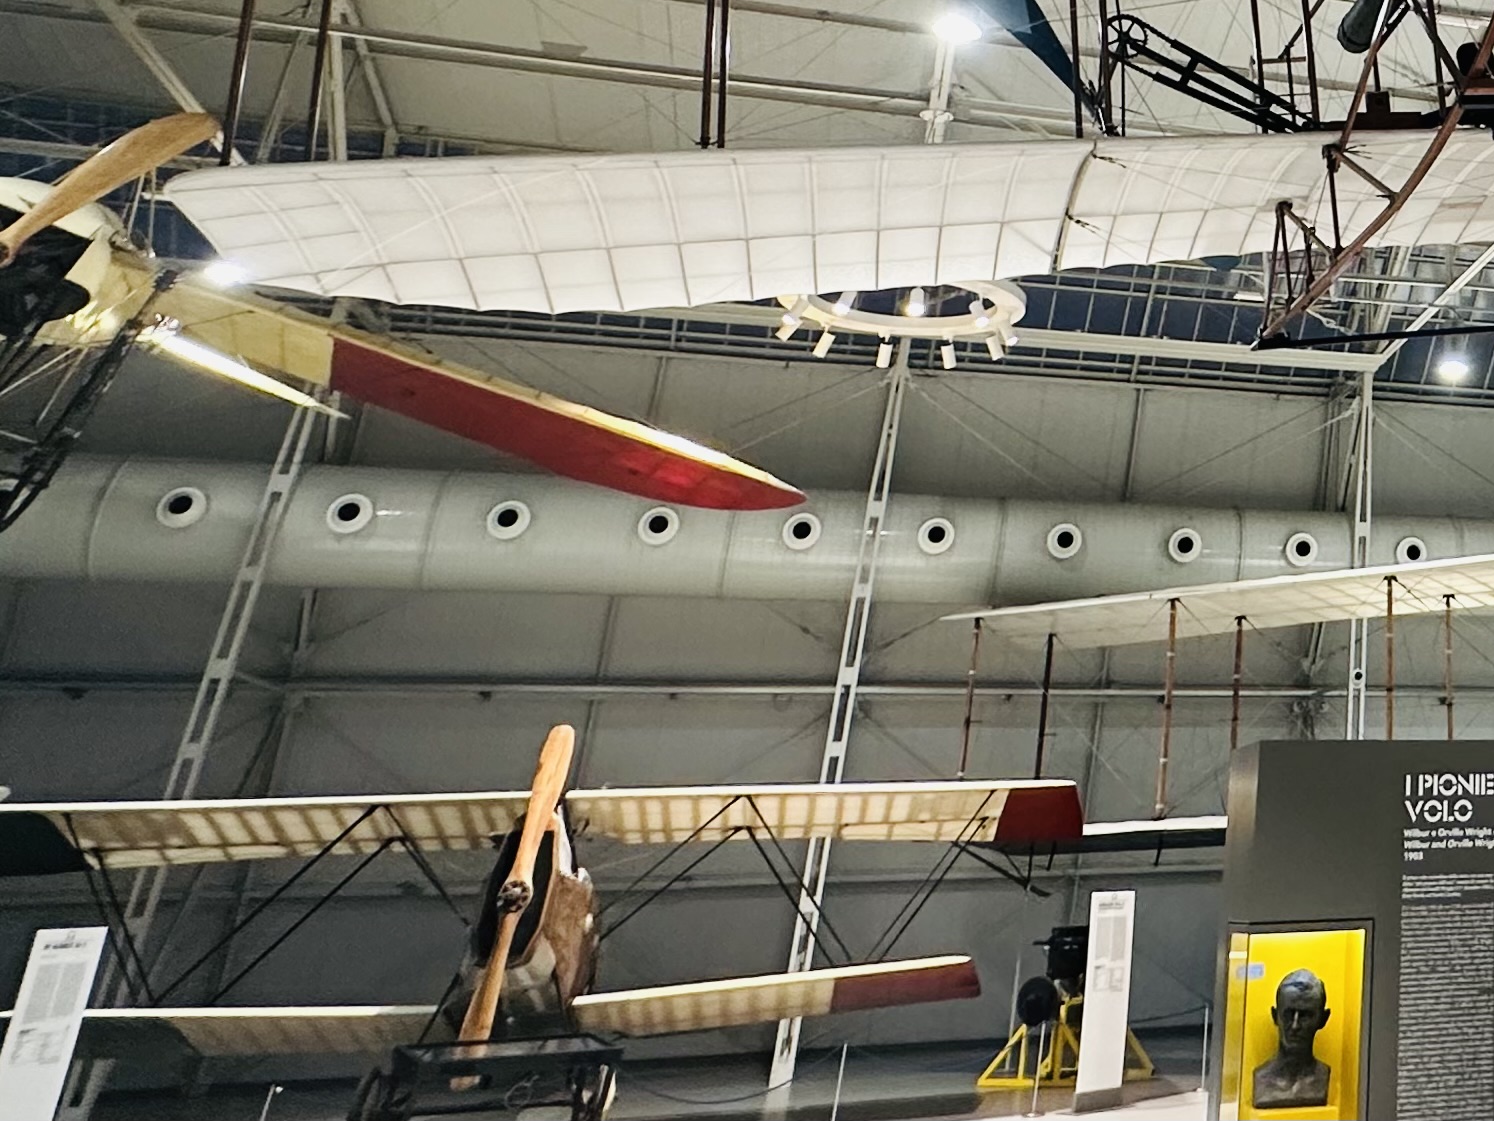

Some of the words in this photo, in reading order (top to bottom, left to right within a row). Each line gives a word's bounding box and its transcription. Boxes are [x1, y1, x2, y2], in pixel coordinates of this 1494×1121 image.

[1405, 774, 1412, 796] I
[1404, 798, 1473, 823] VOLO
[1403, 828, 1430, 838] Wilbur
[1438, 828, 1464, 837] Orville
[1465, 827, 1492, 838] Wright
[1403, 839, 1430, 849] Wilbur
[1431, 839, 1446, 849] and
[1447, 838, 1473, 848] Orville
